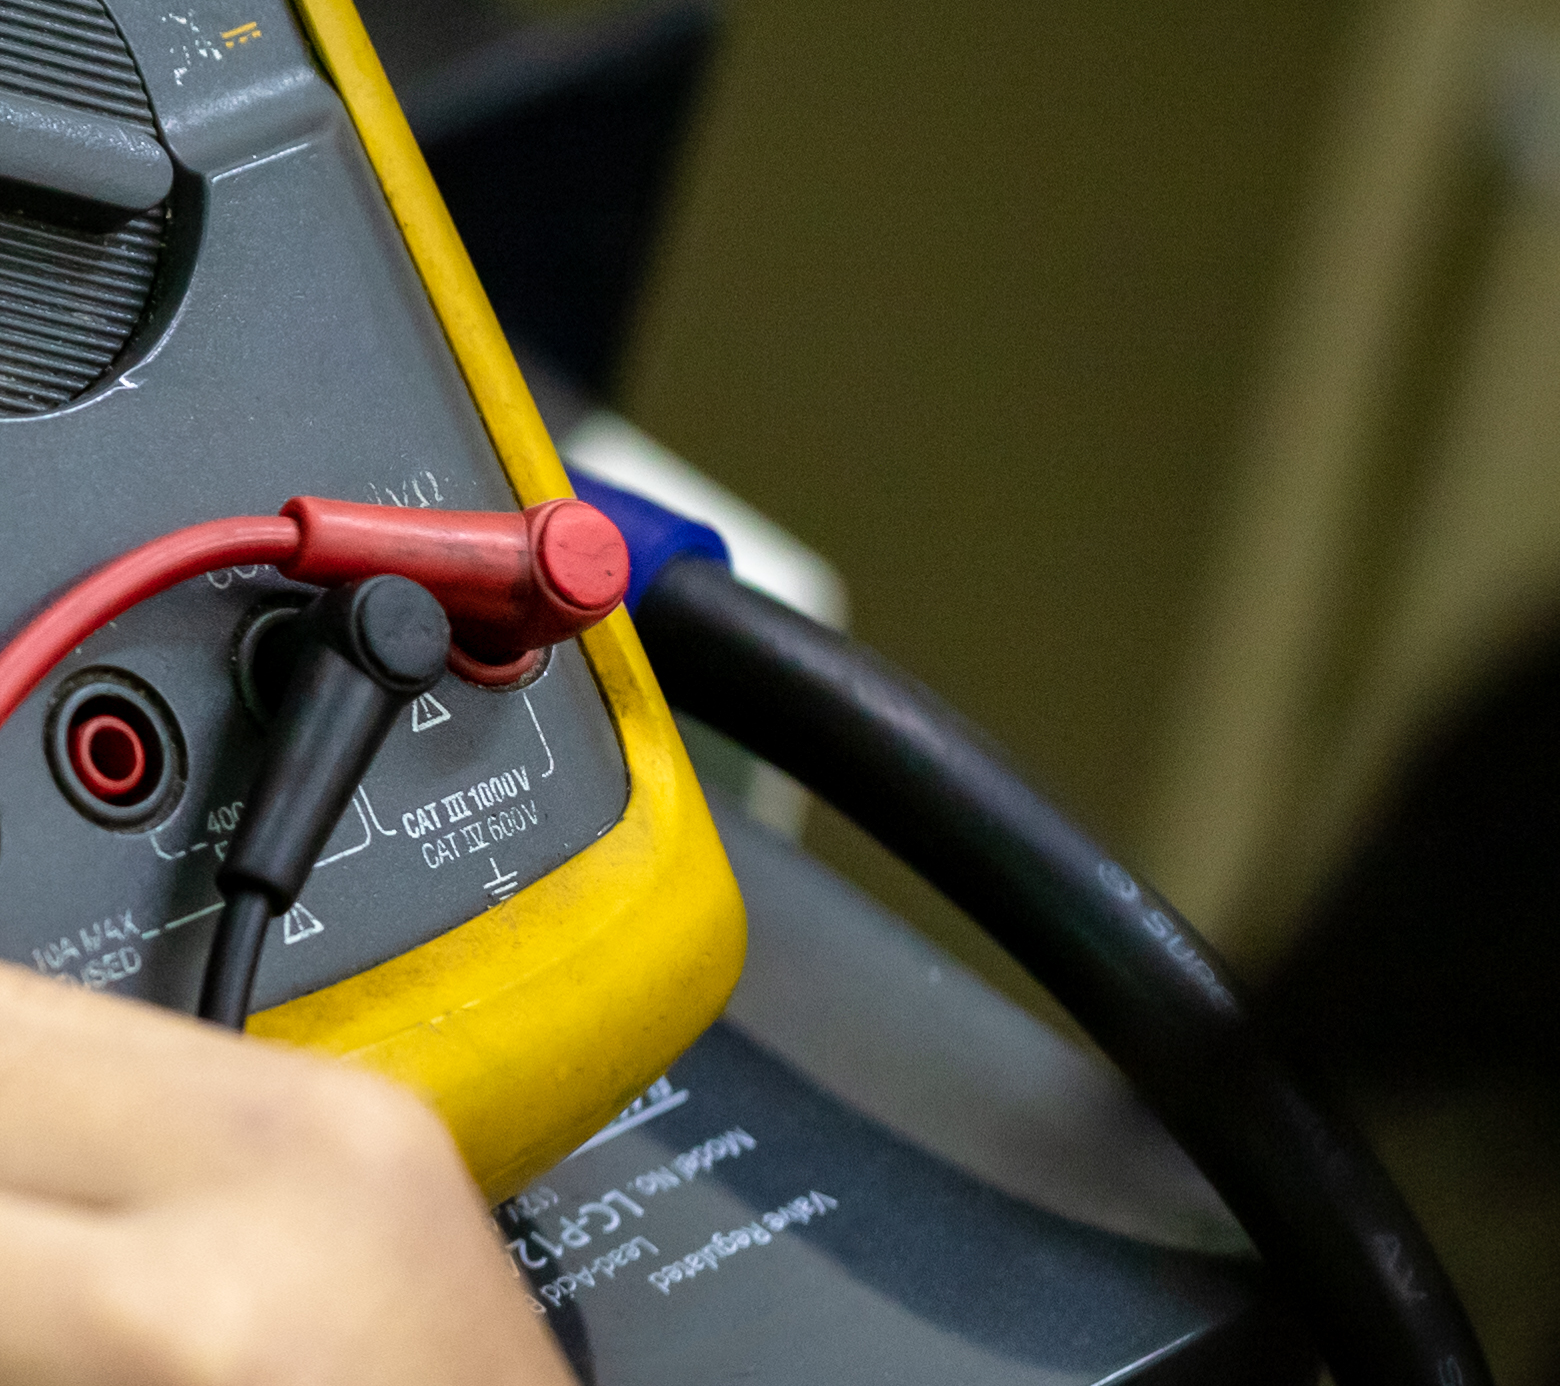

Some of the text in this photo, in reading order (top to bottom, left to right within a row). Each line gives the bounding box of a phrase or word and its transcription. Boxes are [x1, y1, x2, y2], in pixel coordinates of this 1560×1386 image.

[403, 766, 531, 839] CAT III 1000V
[422, 835, 463, 870] CAT
[490, 800, 540, 844] 600V
[672, 1126, 757, 1181] Model
[505, 1188, 645, 1277] LC-P12
[648, 1221, 772, 1295] Regulated
[540, 1236, 659, 1306] Lead-Acid
